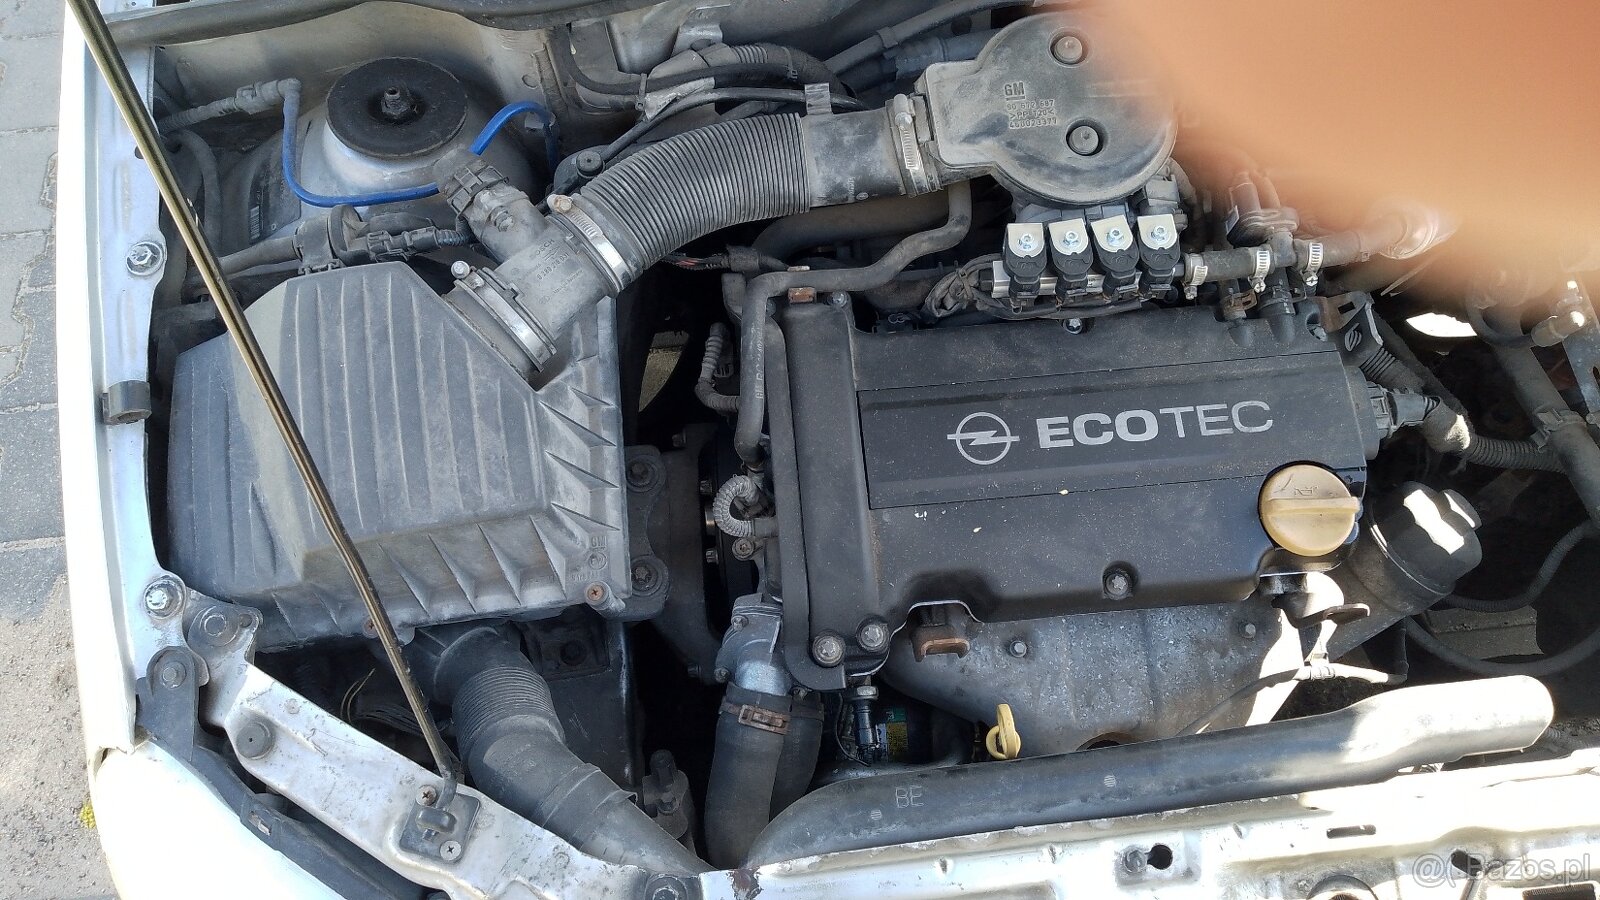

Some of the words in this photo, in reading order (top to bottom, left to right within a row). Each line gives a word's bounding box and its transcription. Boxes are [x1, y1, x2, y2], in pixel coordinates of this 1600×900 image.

[1004, 82, 1025, 96] GM
[1036, 400, 1274, 449] ECOTEC
[895, 784, 924, 809] BE
